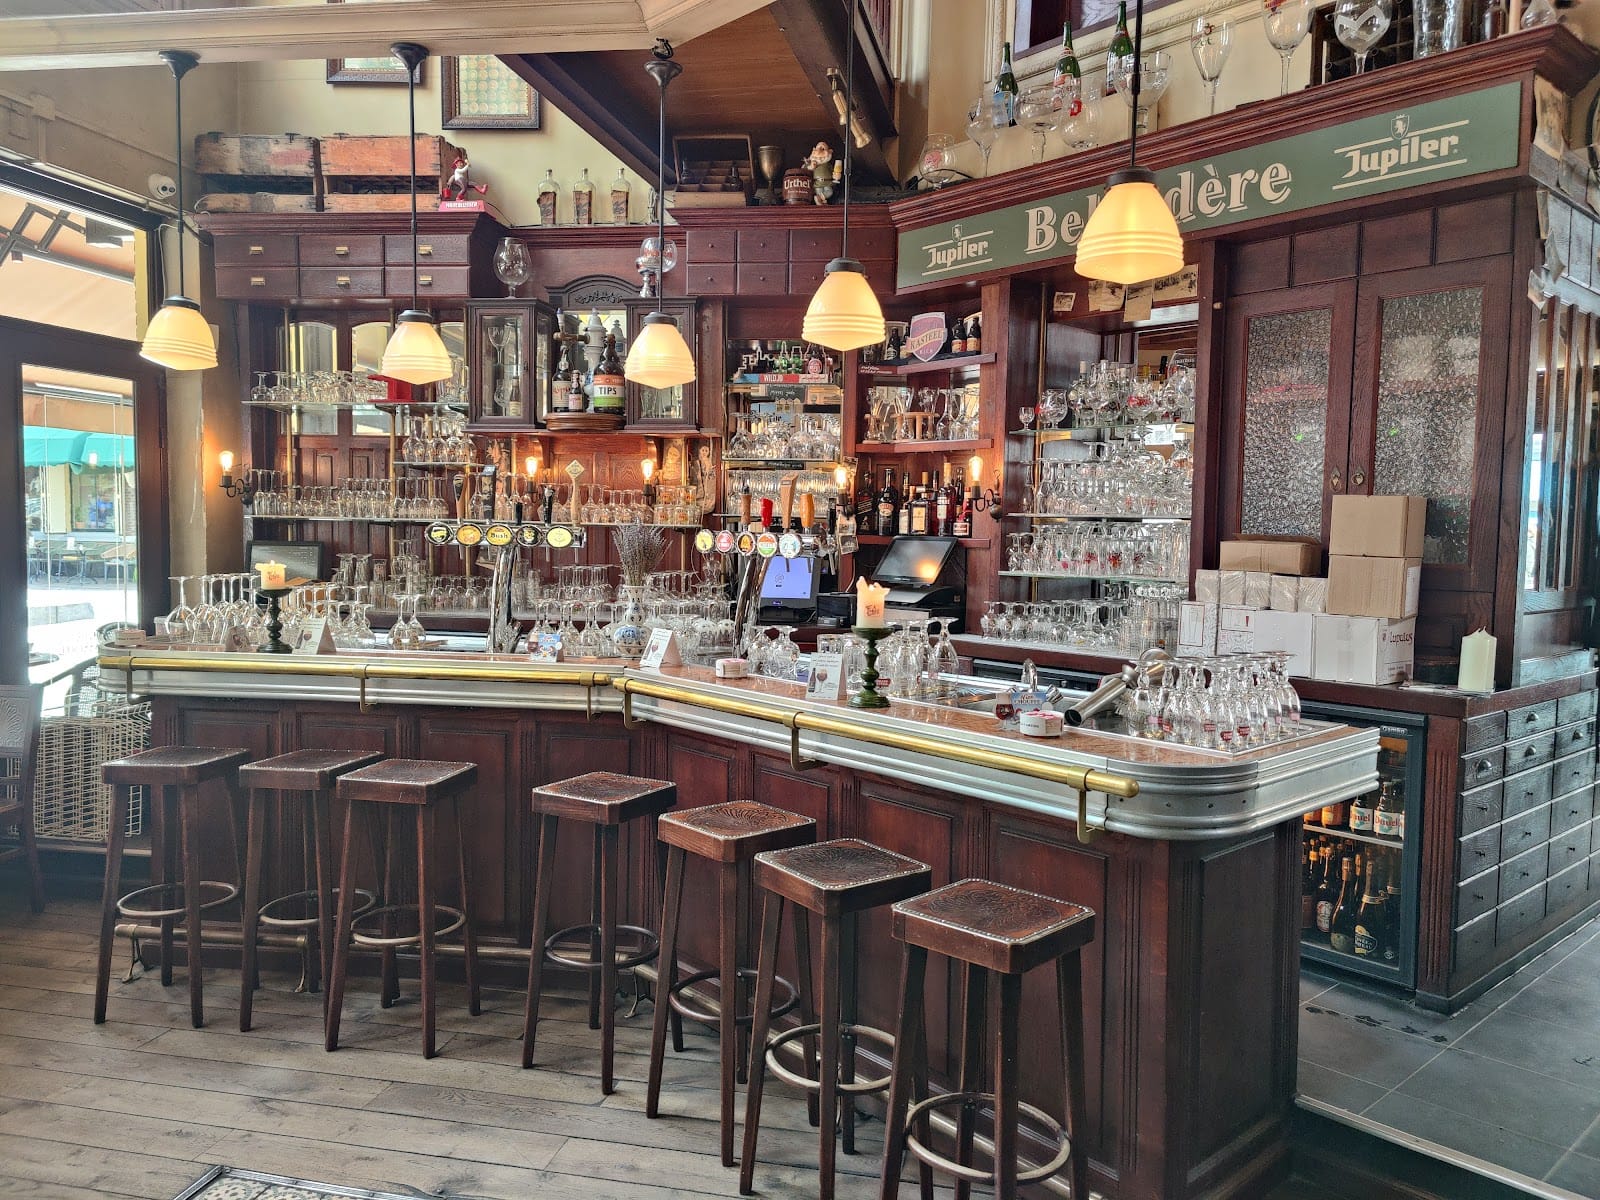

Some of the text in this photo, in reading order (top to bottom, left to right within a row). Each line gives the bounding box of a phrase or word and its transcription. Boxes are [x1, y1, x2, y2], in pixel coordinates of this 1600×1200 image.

[1342, 134, 1459, 178] Jupiler
[784, 178, 810, 190] Urthel
[1024, 162, 1292, 254] Bedère
[926, 240, 988, 268] Jupiler
[910, 330, 944, 350] KASTEEL
[598, 386, 617, 395] TIPS
